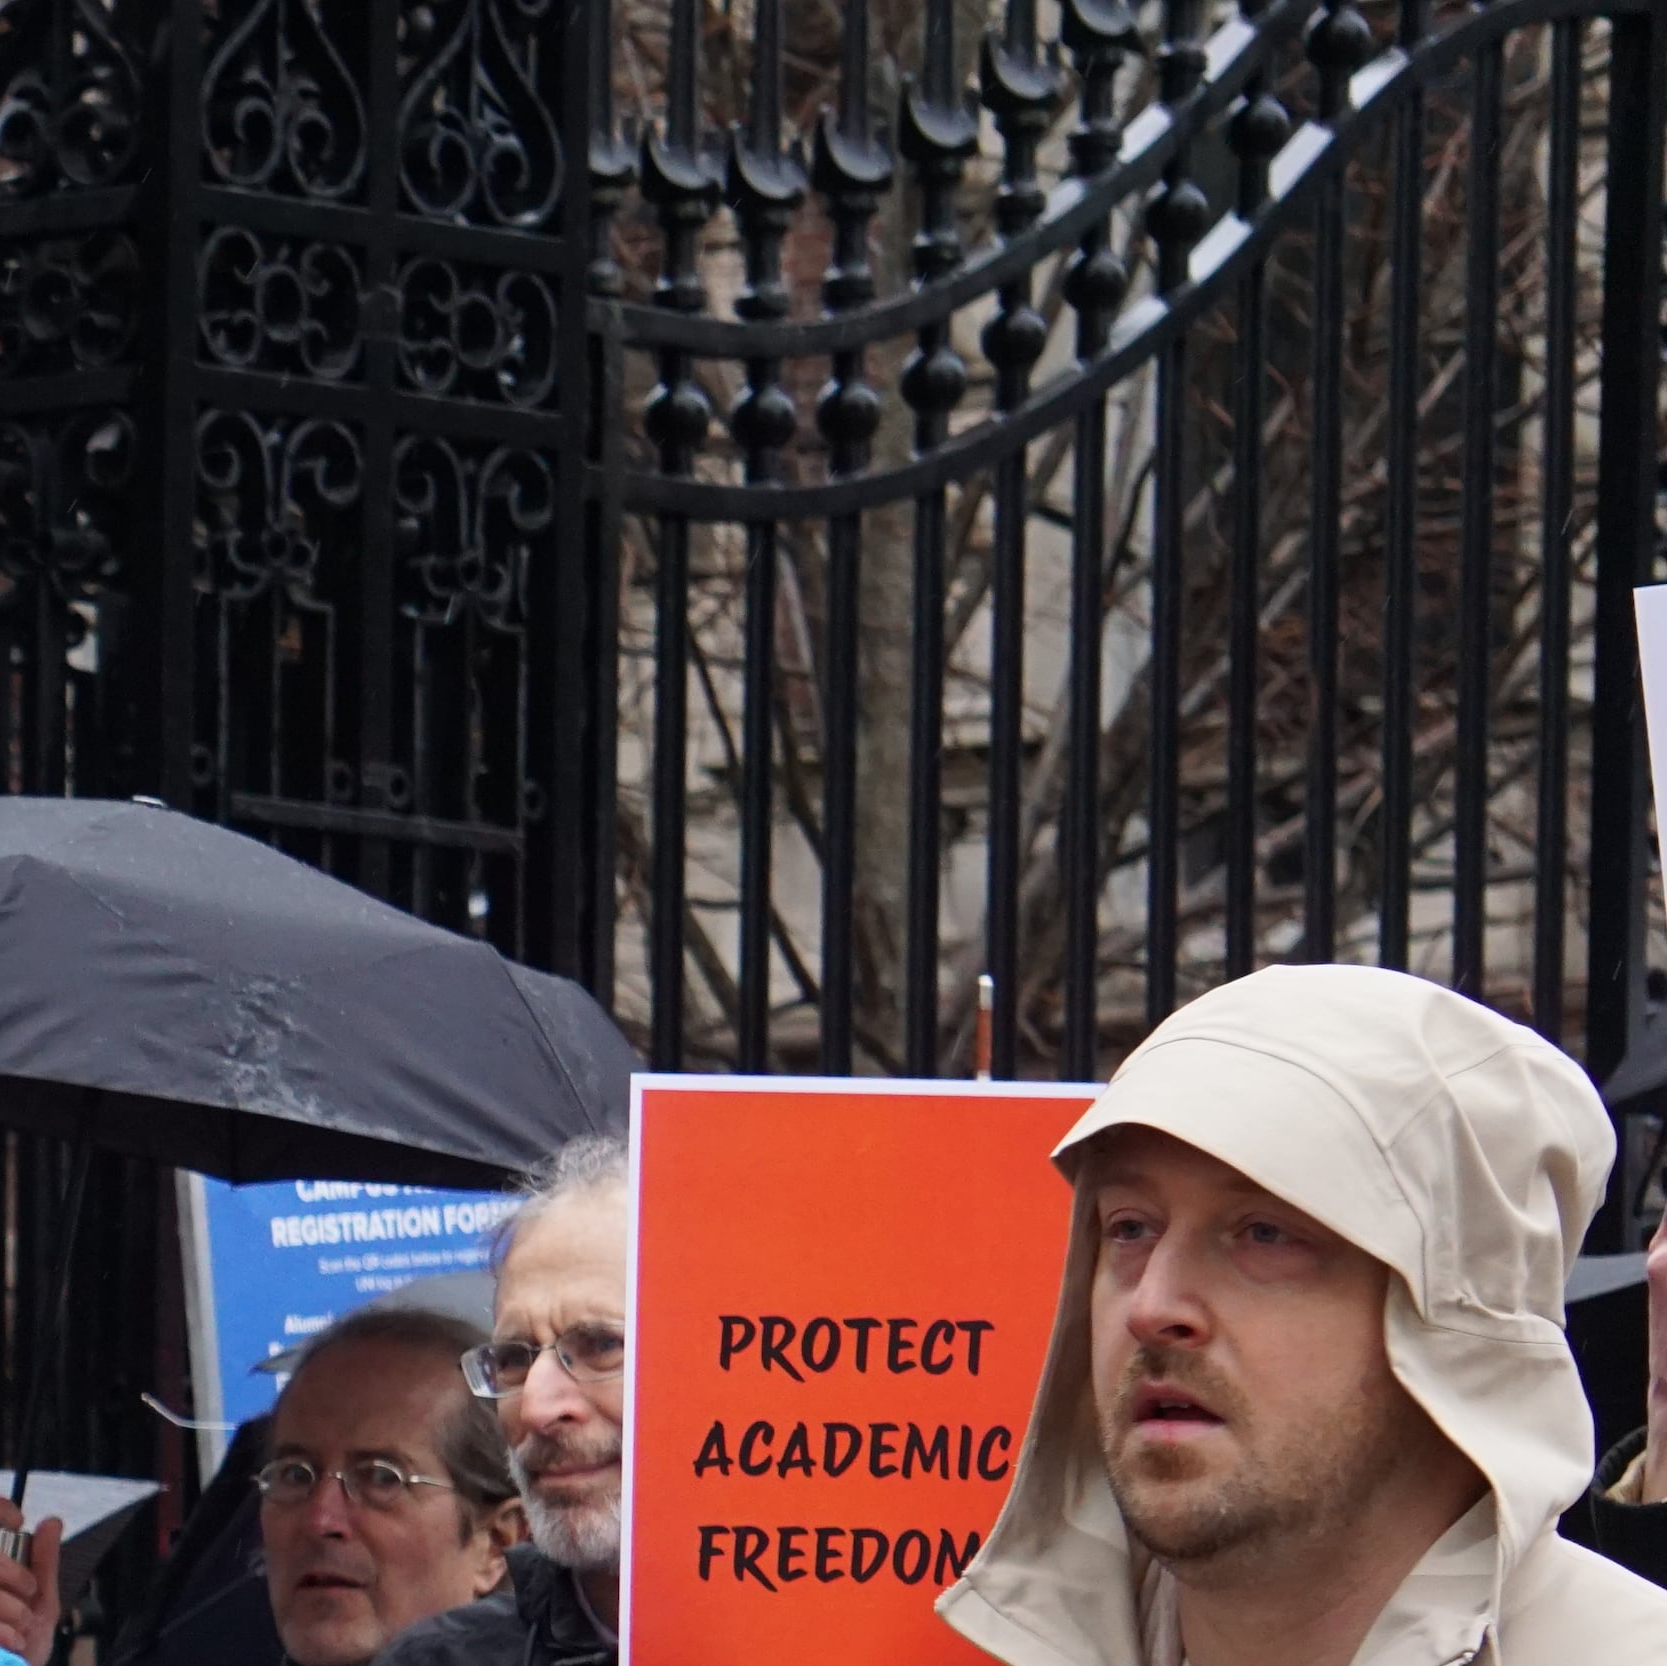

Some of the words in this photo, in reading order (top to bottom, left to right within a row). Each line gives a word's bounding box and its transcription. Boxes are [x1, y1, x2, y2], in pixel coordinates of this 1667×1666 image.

[270, 1207, 440, 1248] REGISTRATION
[717, 1314, 995, 1382] PROTECT
[693, 1420, 1012, 1482] ACADEMIC
